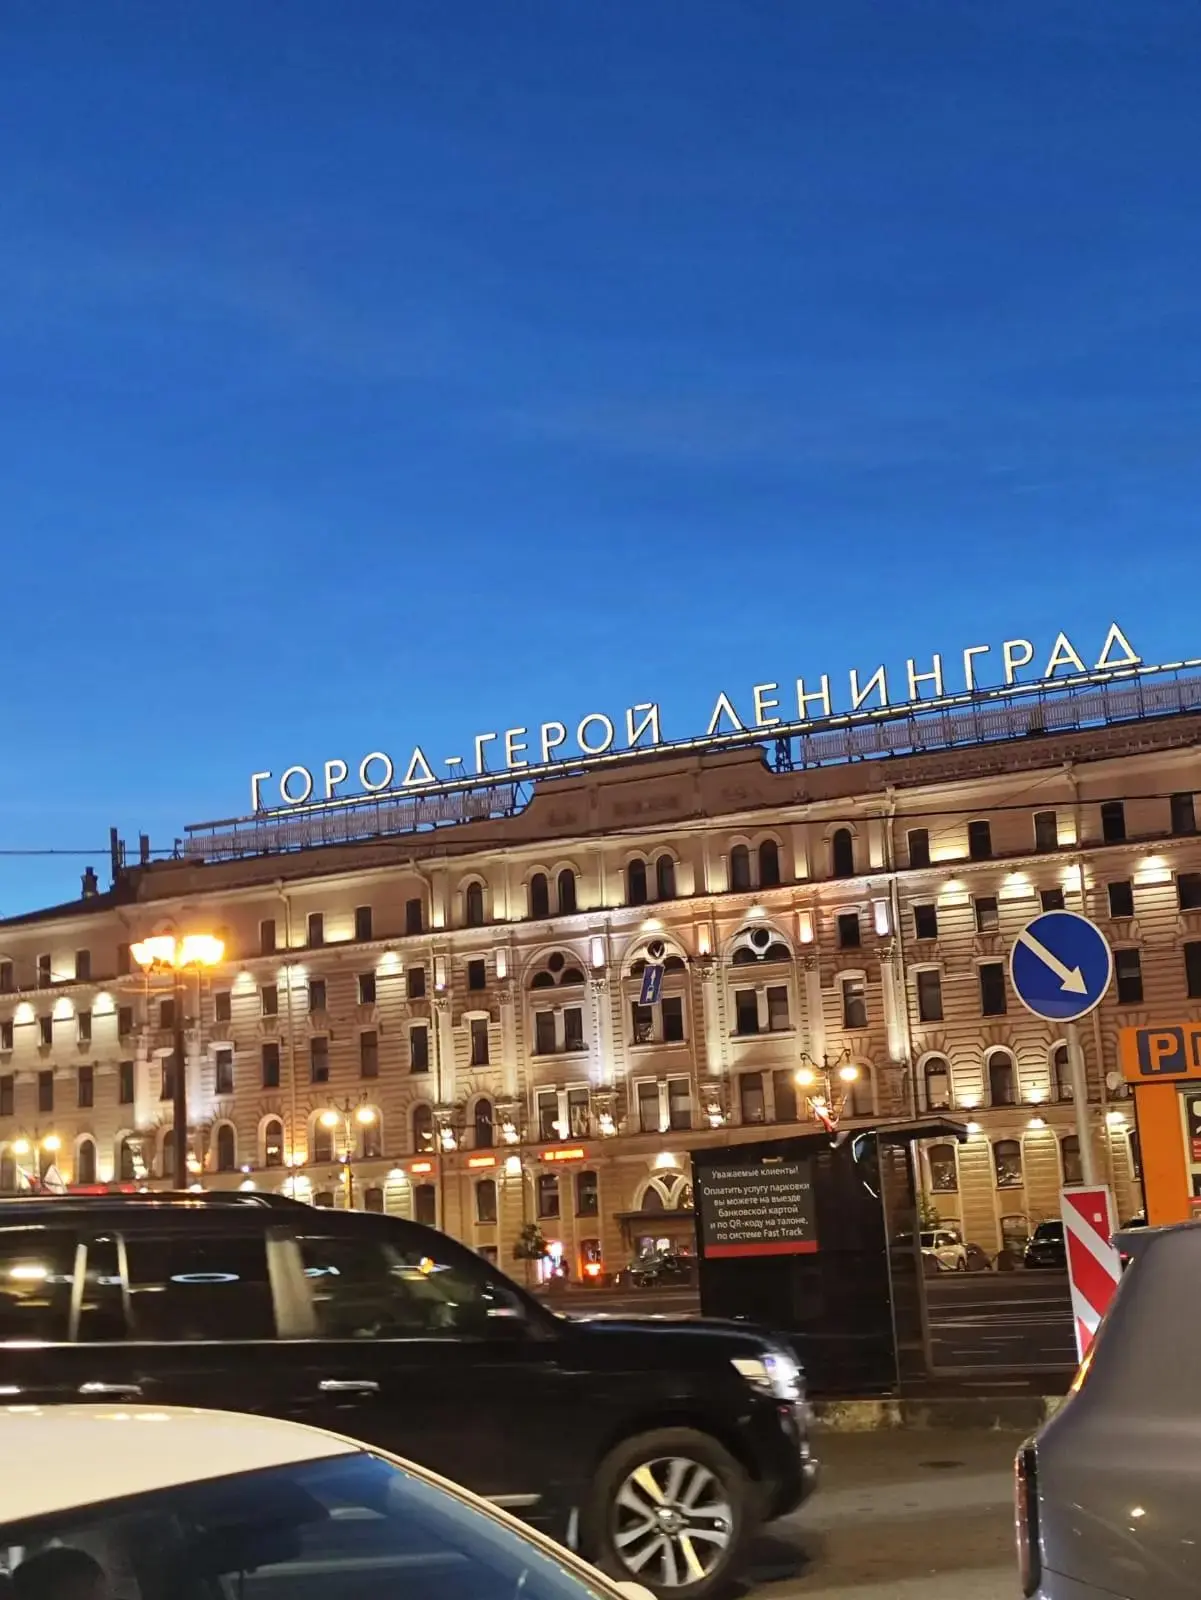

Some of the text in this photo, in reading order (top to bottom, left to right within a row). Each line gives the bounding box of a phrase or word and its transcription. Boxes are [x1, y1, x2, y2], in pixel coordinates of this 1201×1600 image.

[706, 621, 1143, 734] ЛЕНИНГРАД
[711, 1165, 799, 1179] Уважаемые клиенты!
[703, 1182, 810, 1196] Оплатить услугу парковки
[713, 1194, 801, 1207] вы можете на выезде
[768, 1204, 799, 1216] картой
[717, 1221, 728, 1229] по
[729, 1219, 763, 1229] QR-коду
[765, 1218, 776, 1227] на
[716, 1232, 728, 1240] по
[729, 1230, 762, 1240] системе
[763, 1228, 780, 1238] Fast
